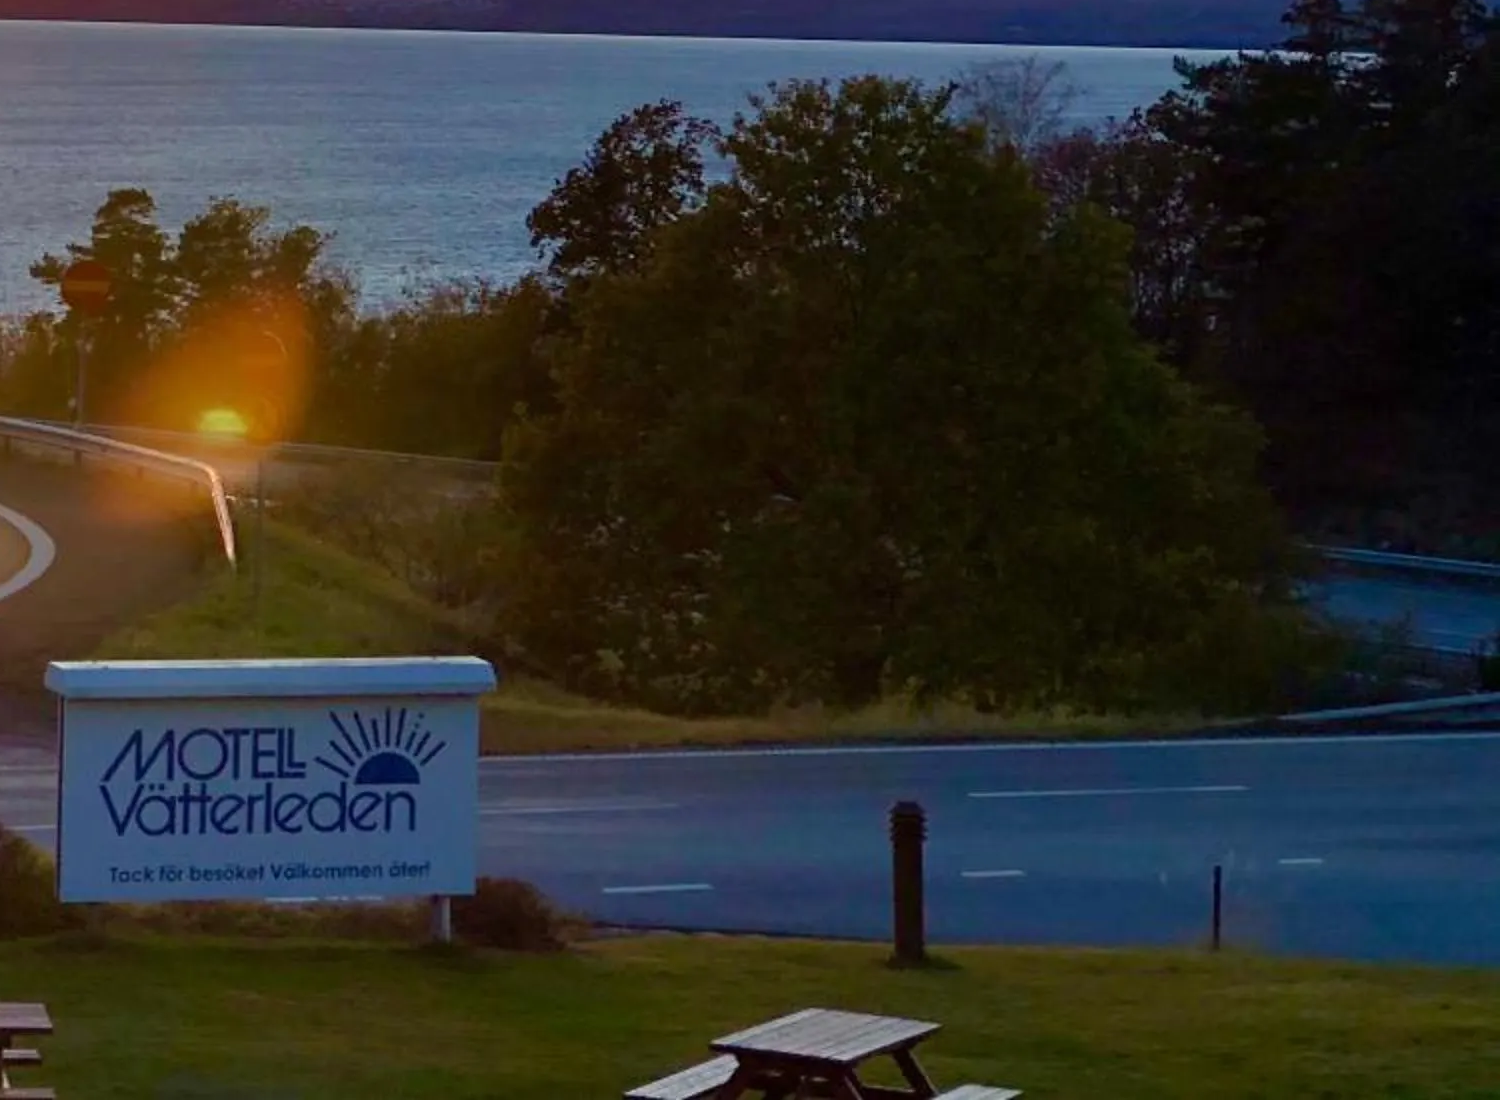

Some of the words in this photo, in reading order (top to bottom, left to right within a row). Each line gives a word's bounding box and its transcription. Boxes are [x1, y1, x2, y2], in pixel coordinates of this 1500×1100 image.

[101, 728, 307, 782] MOTELL
[99, 781, 417, 836] Vätterleden
[109, 866, 154, 883] Tack
[158, 864, 184, 882] för
[189, 862, 265, 882] besöket
[270, 861, 383, 880] Välkommen
